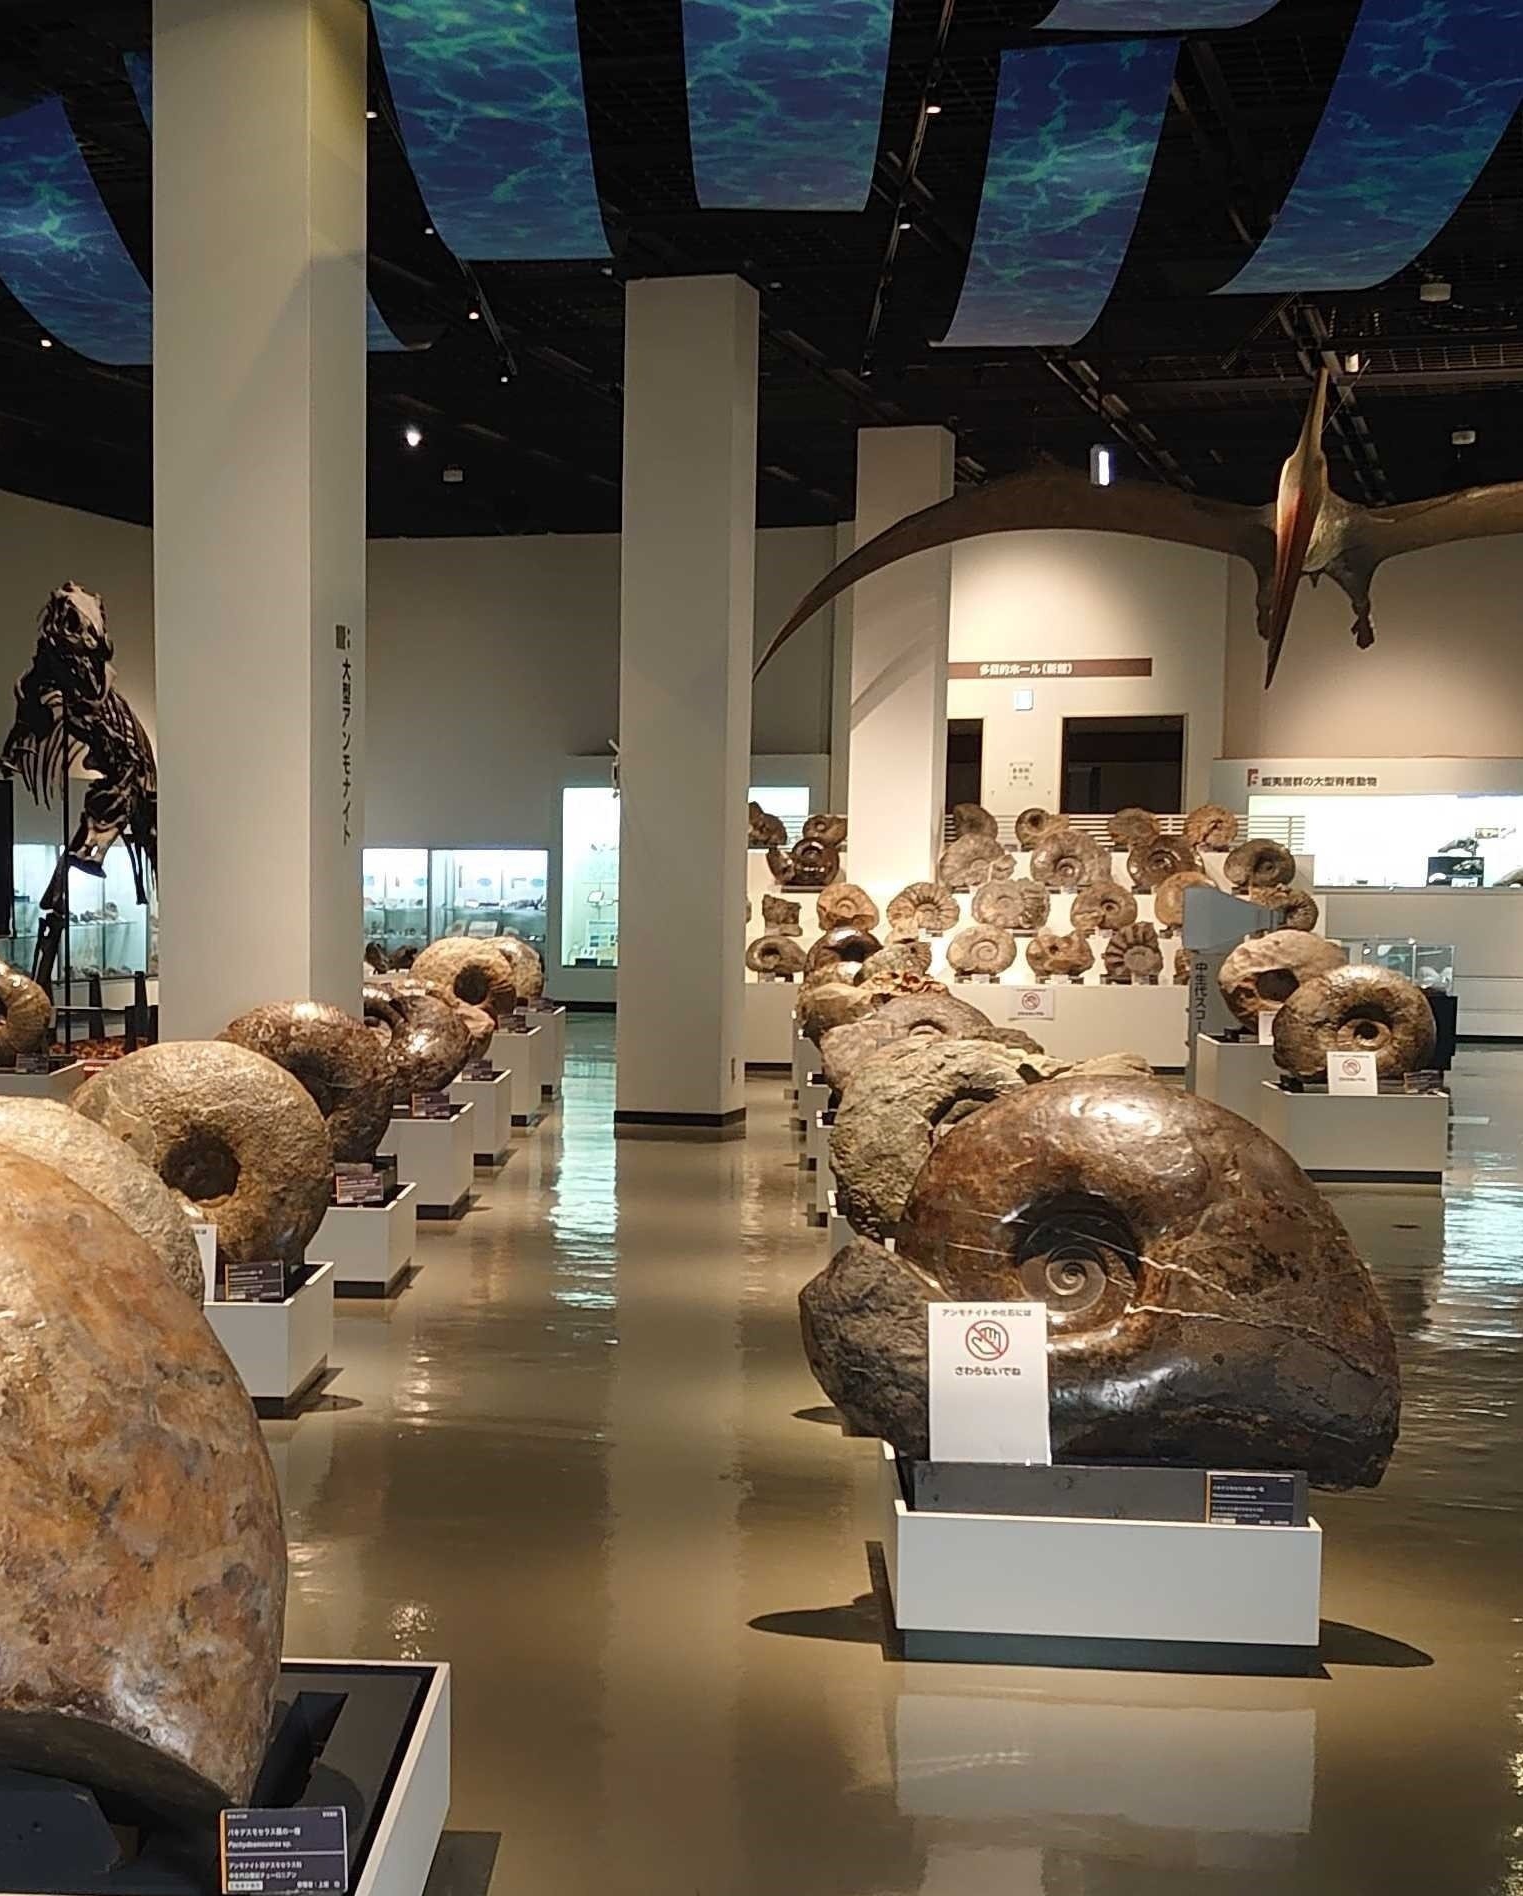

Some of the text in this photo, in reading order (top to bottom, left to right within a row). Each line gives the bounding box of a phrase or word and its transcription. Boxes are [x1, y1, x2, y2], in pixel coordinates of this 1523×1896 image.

[942, 1308, 1032, 1317] アンモナイトの化石には
[955, 1366, 1021, 1376] さわらないでね
